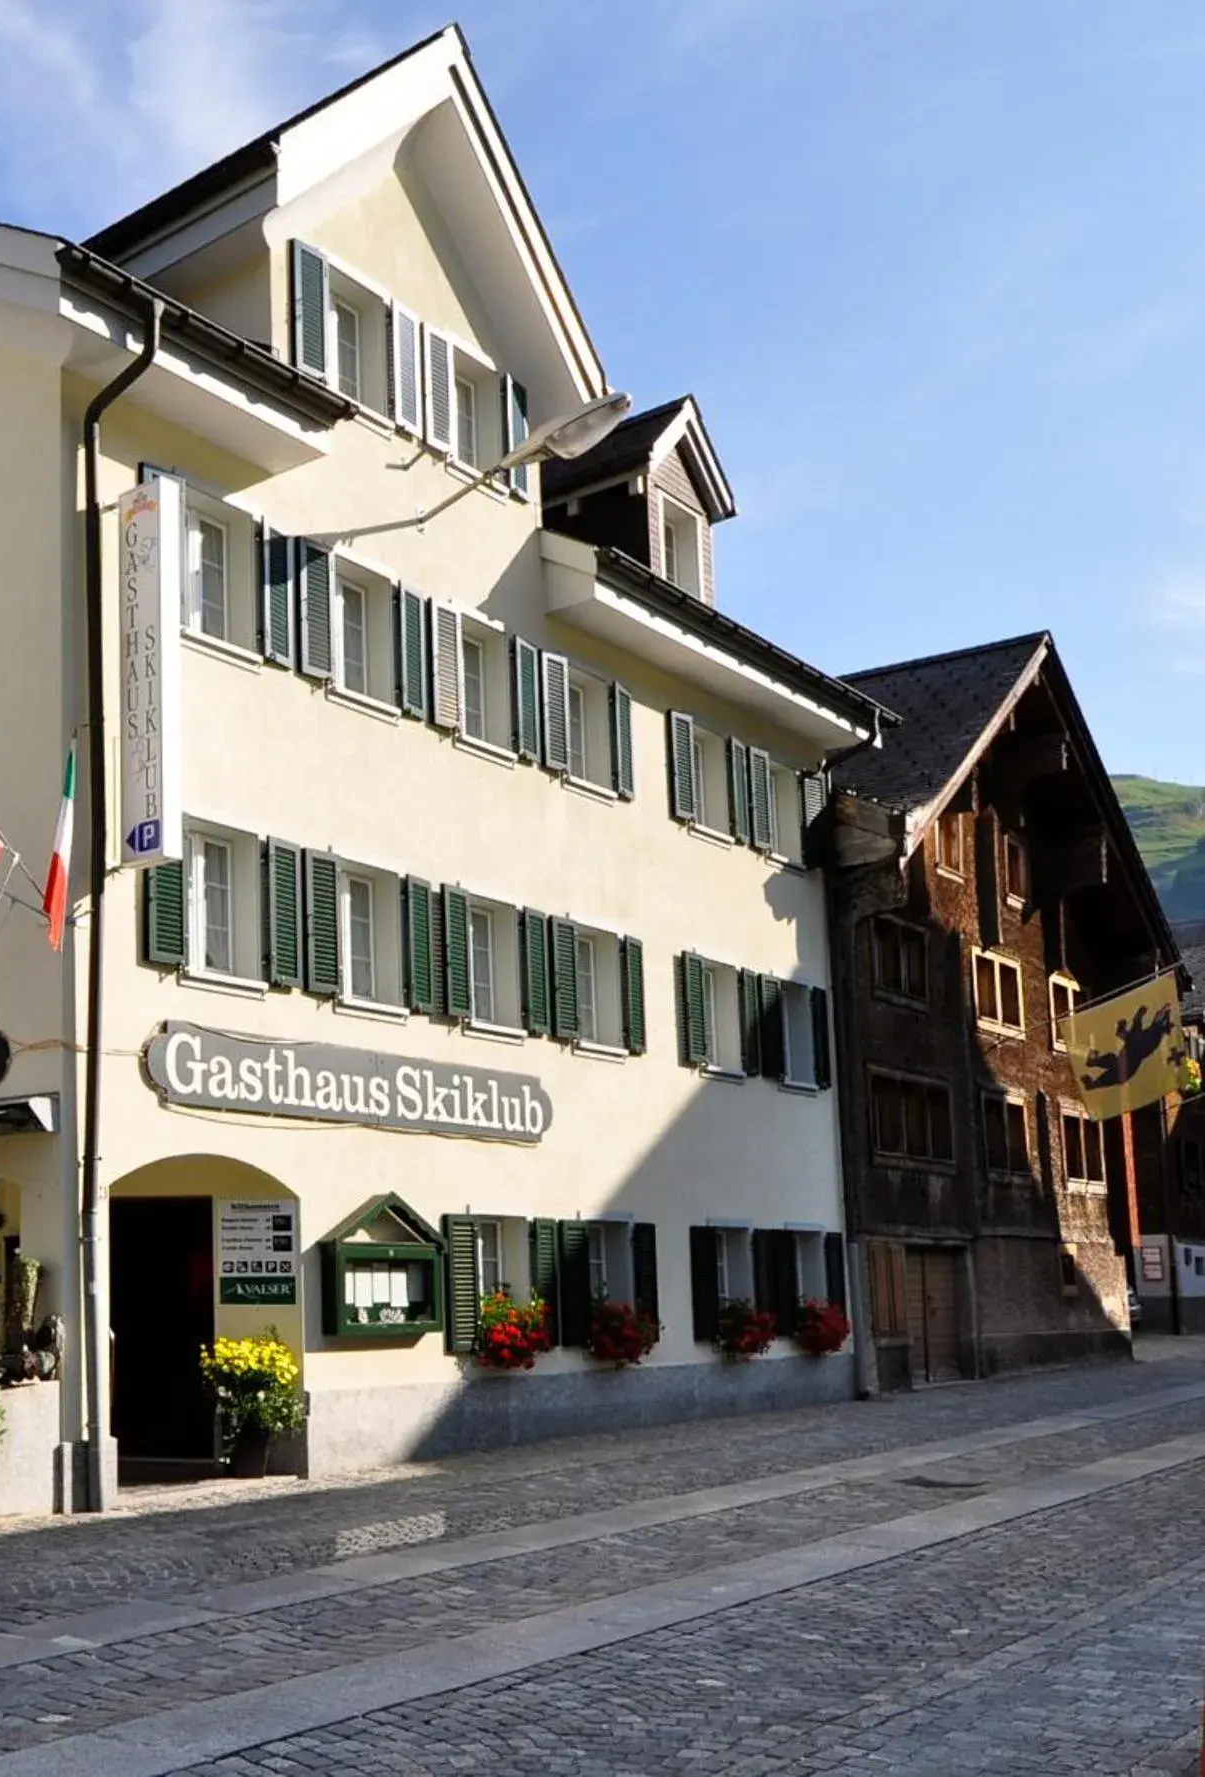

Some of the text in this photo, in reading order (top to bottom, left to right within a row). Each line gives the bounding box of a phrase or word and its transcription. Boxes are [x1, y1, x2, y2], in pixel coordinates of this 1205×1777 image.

[123, 522, 141, 741] GASTHAUS
[142, 624, 158, 818] SKIKLUB
[142, 824, 156, 849] P
[164, 1032, 545, 1136] Gasthaus Skiklub
[244, 1283, 291, 1297] VALSER
